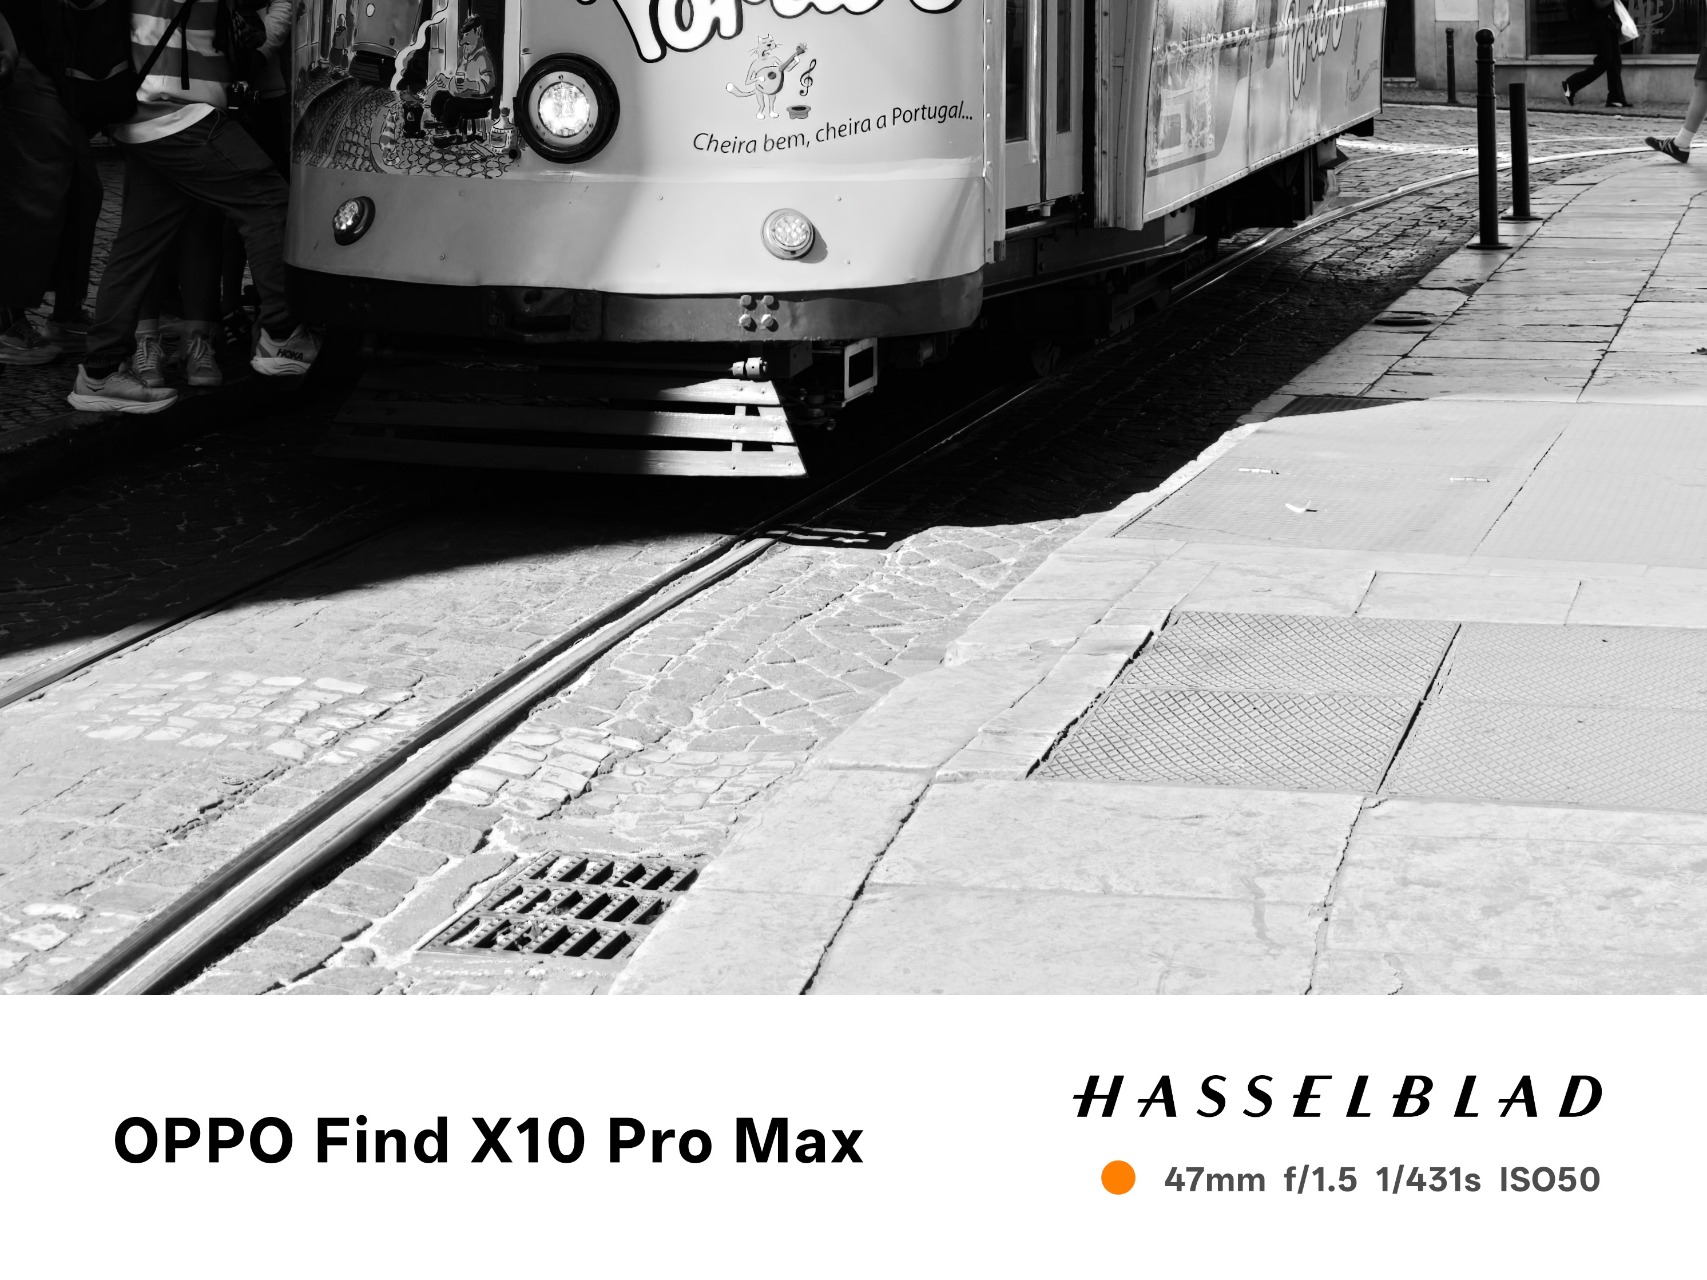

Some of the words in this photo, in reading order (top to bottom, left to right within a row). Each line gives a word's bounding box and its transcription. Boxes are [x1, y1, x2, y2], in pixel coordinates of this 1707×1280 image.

[692, 132, 757, 154] Cheira
[763, 130, 811, 153] bem,
[815, 117, 872, 143] cheira
[876, 114, 887, 129] a
[892, 100, 974, 126] Portugal...
[276, 348, 304, 361] HOKA
